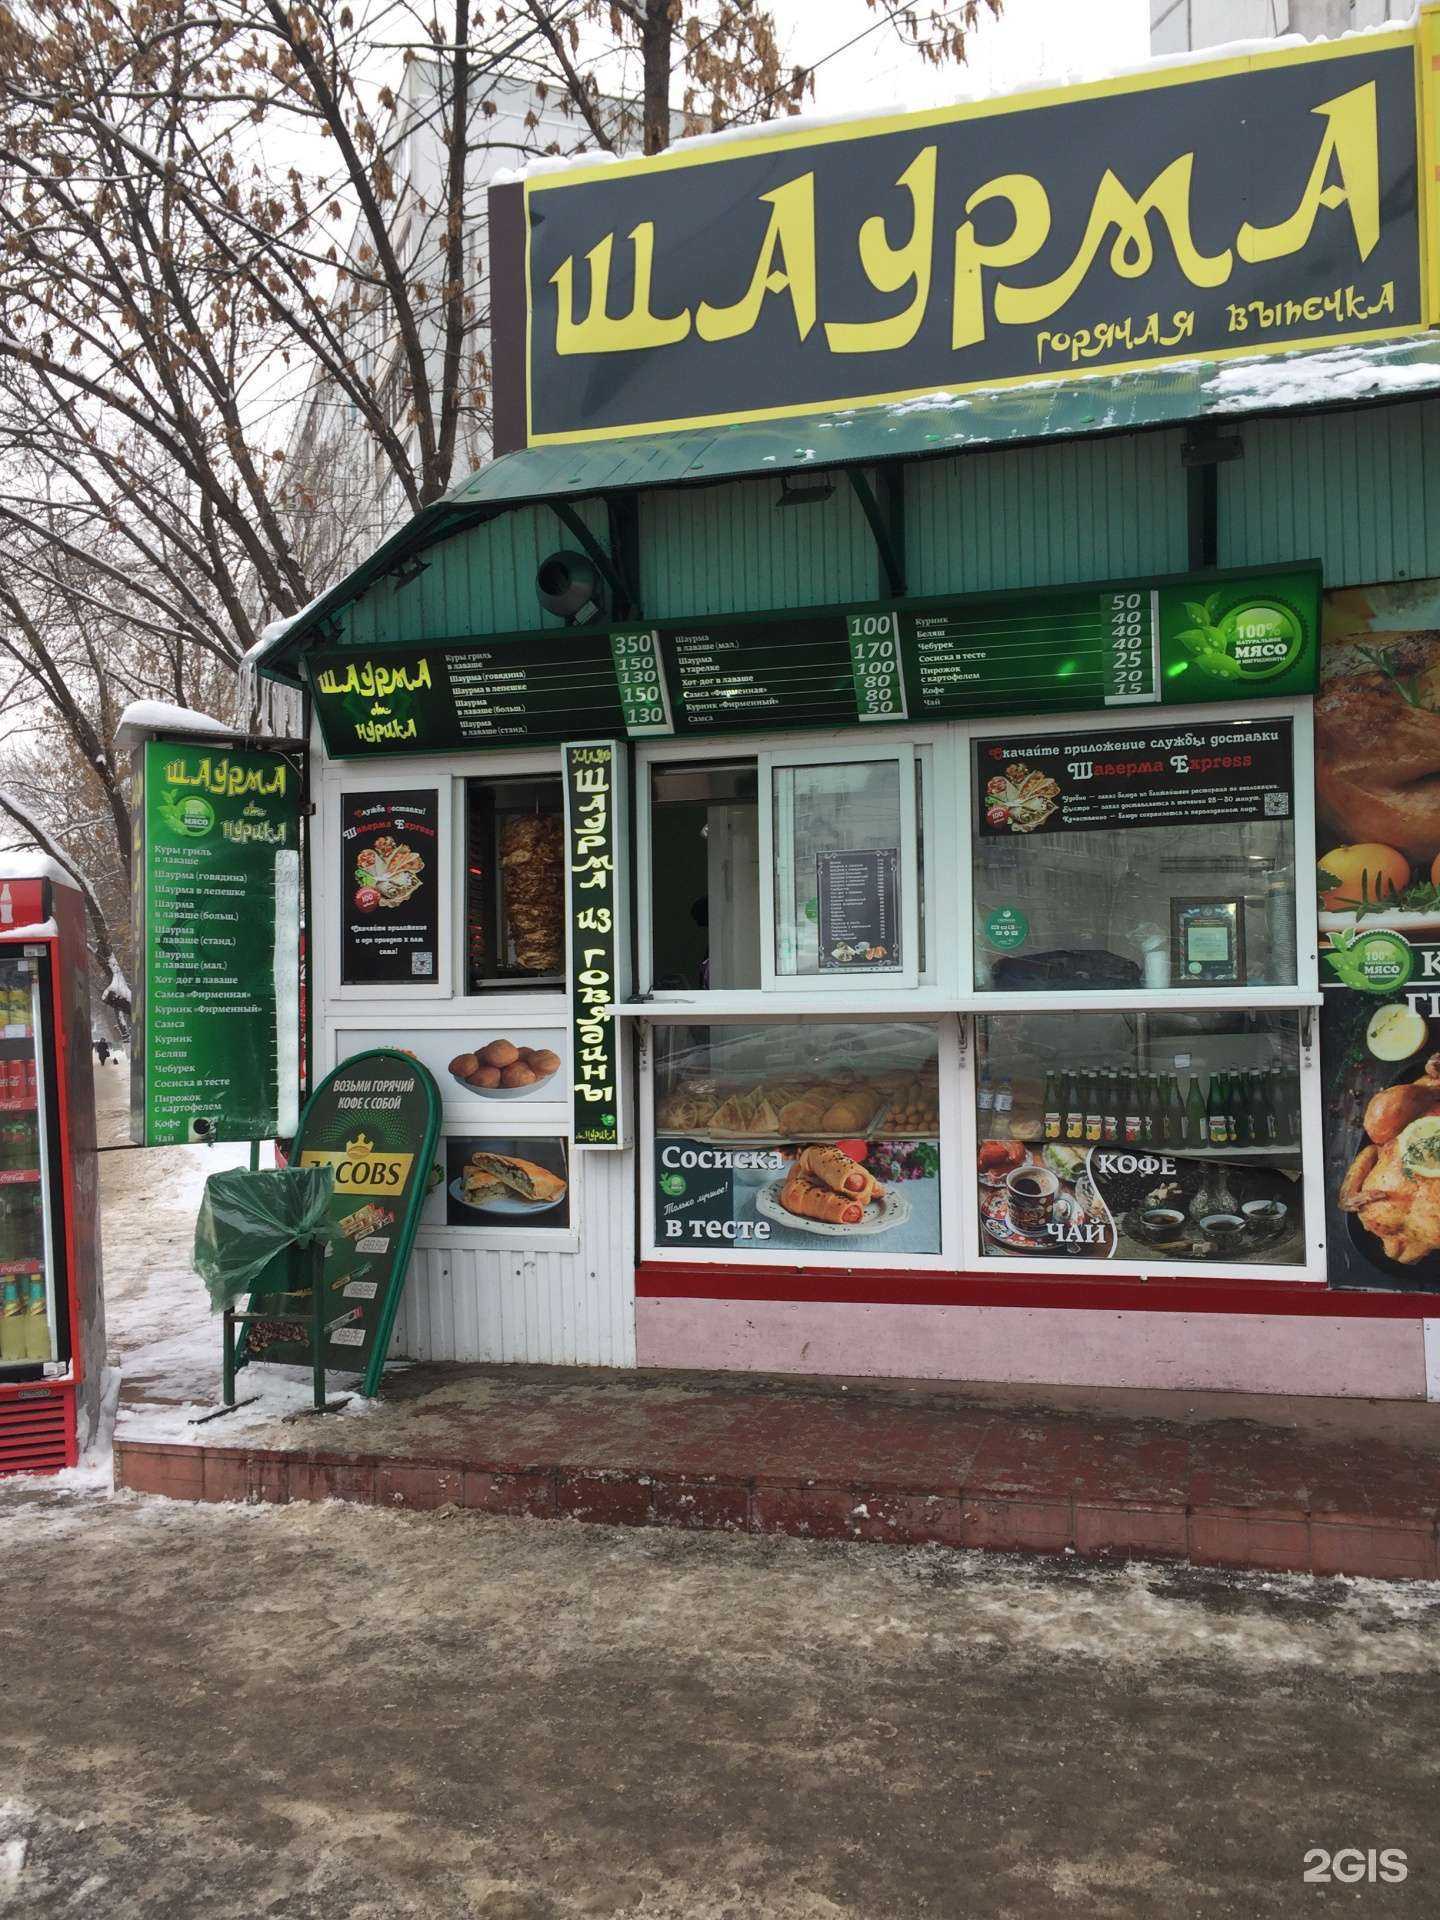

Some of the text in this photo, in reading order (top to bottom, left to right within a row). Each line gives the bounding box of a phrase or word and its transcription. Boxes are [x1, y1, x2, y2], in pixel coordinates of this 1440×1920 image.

[549, 80, 1380, 355] ШАУРМА
[1037, 281, 1395, 364] ГОРЯЧАЯ ВЫПЕЧКА
[1111, 593, 1141, 610] 50
[915, 617, 949, 627] Курник
[1112, 611, 1141, 624] 40
[851, 616, 890, 636] 100
[1112, 624, 1141, 636] 40
[1237, 623, 1281, 639] 100%
[675, 635, 709, 644] Шаурма
[916, 630, 945, 638] Беляш
[615, 635, 651, 654] 350
[918, 642, 954, 651] Чебурек
[1112, 637, 1142, 649] 40
[854, 641, 893, 659] 170
[1235, 643, 1288, 658] МЯСО
[679, 656, 712, 665] Шаурма
[918, 654, 955, 662] Сосиска
[962, 652, 987, 660] тесте
[1113, 651, 1142, 668] 25
[618, 657, 654, 671] 150
[686, 665, 720, 674] тарелке
[857, 661, 895, 675] 100
[920, 666, 961, 675] Пирожок
[1113, 670, 1143, 682] 20
[317, 658, 432, 697] ШАУРМА
[450, 674, 482, 684] Шаурма
[621, 671, 656, 684] 130
[722, 676, 754, 684] лаваше
[864, 675, 891, 688] 80
[927, 673, 981, 684] картофелем
[452, 687, 485, 696] Шаурма
[624, 687, 659, 702] 150
[866, 688, 892, 701] 80
[922, 687, 945, 695] Кофе
[1115, 683, 1142, 694] 15
[455, 699, 487, 708] Шаурма
[686, 703, 719, 712] Курник
[867, 701, 893, 714] 50
[924, 698, 941, 706] Чай
[627, 707, 662, 723] 130
[355, 718, 417, 743] НУРИКА
[459, 720, 492, 729] Шаурма
[1064, 740, 1146, 756] приложение
[1150, 733, 1205, 749] службы
[1210, 731, 1279, 748] доставки
[1067, 753, 1253, 780] Шаверма Express
[164, 757, 287, 797] ШАУРМА
[222, 820, 287, 844] НУРИКА
[154, 845, 212, 857] Куры гриль
[154, 870, 248, 883] Шаурма (говядина)
[154, 884, 195, 895] Шаурма
[203, 888, 246, 897] лепешке
[154, 899, 194, 909] Шаурма
[162, 911, 199, 919] лаваше
[200, 910, 239, 922] (больш.)
[154, 926, 194, 936] Шаурма
[162, 937, 199, 945] лаваше
[200, 935, 236, 947] (станд.)
[154, 951, 194, 961] Шаурма
[162, 962, 199, 970] лаваше
[200, 960, 228, 971] (мал.)
[1364, 965, 1401, 975] МЯСО
[154, 989, 251, 1001] Самса «Фирменная»
[154, 1005, 192, 1015] Курник
[154, 1020, 185, 1028] Самса
[154, 1034, 192, 1045] Курник
[154, 1049, 188, 1058] Беляш
[154, 1064, 196, 1074] Чебурек
[154, 1079, 195, 1088] Сосиска
[204, 1078, 230, 1086] тесте
[333, 1078, 415, 1093] ВОЗЬМИ ГОРЯЧИЙ
[154, 1093, 201, 1103] Пирожок
[337, 1096, 402, 1109] КОФЕ С СОБОЙ
[161, 1103, 222, 1113] картофелем
[154, 1119, 181, 1129] Кофе
[155, 1134, 175, 1142] Чай
[661, 1145, 784, 1170] Сосиска
[1098, 1154, 1177, 1176] КОФЕ
[664, 1198, 694, 1216] Только
[665, 1219, 772, 1240] в тесте
[1046, 1218, 1107, 1244] ЧАЙ
